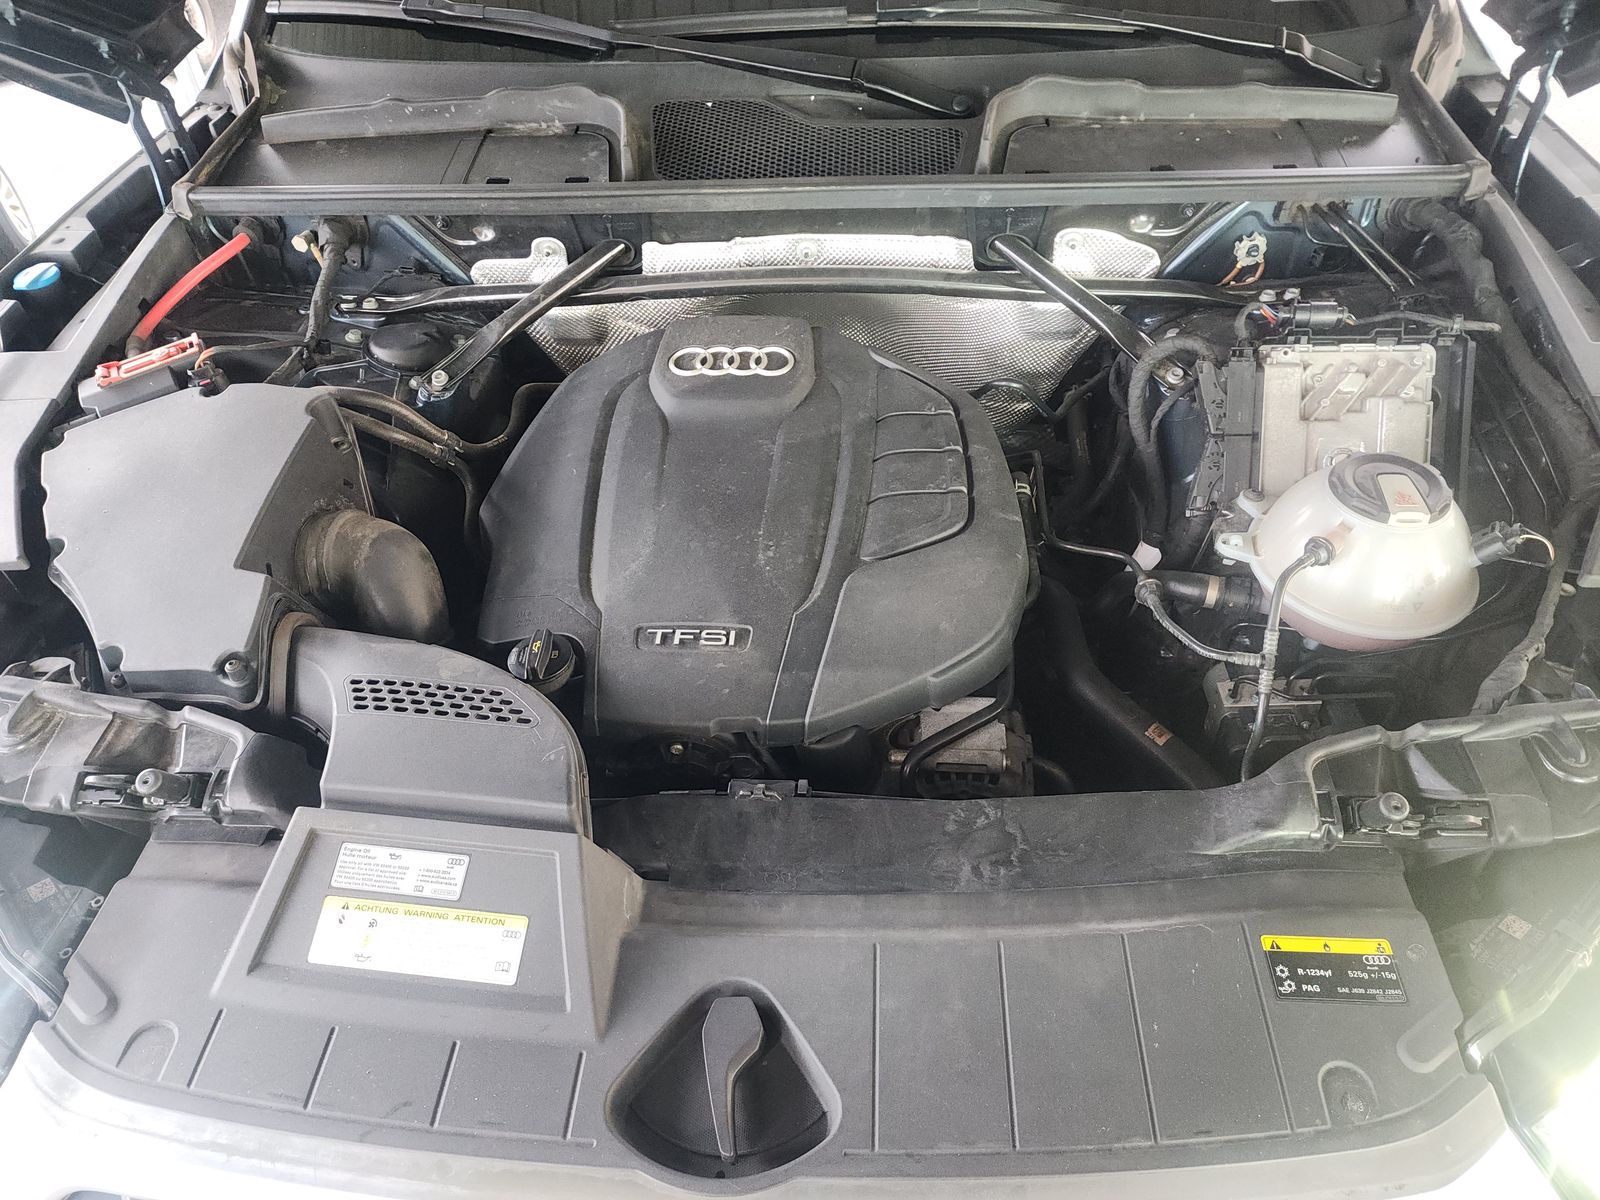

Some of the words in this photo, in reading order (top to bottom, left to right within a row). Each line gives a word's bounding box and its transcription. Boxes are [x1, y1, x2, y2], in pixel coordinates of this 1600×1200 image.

[646, 629, 736, 646] TFSI
[343, 846, 363, 854] Engine
[354, 904, 399, 915] ACHTUNG
[403, 909, 450, 921] WARNING
[453, 914, 507, 926] ATTENTION
[1297, 968, 1333, 978] R-1234yf
[1347, 970, 1369, 980] 525g
[1302, 984, 1321, 993] PAG
